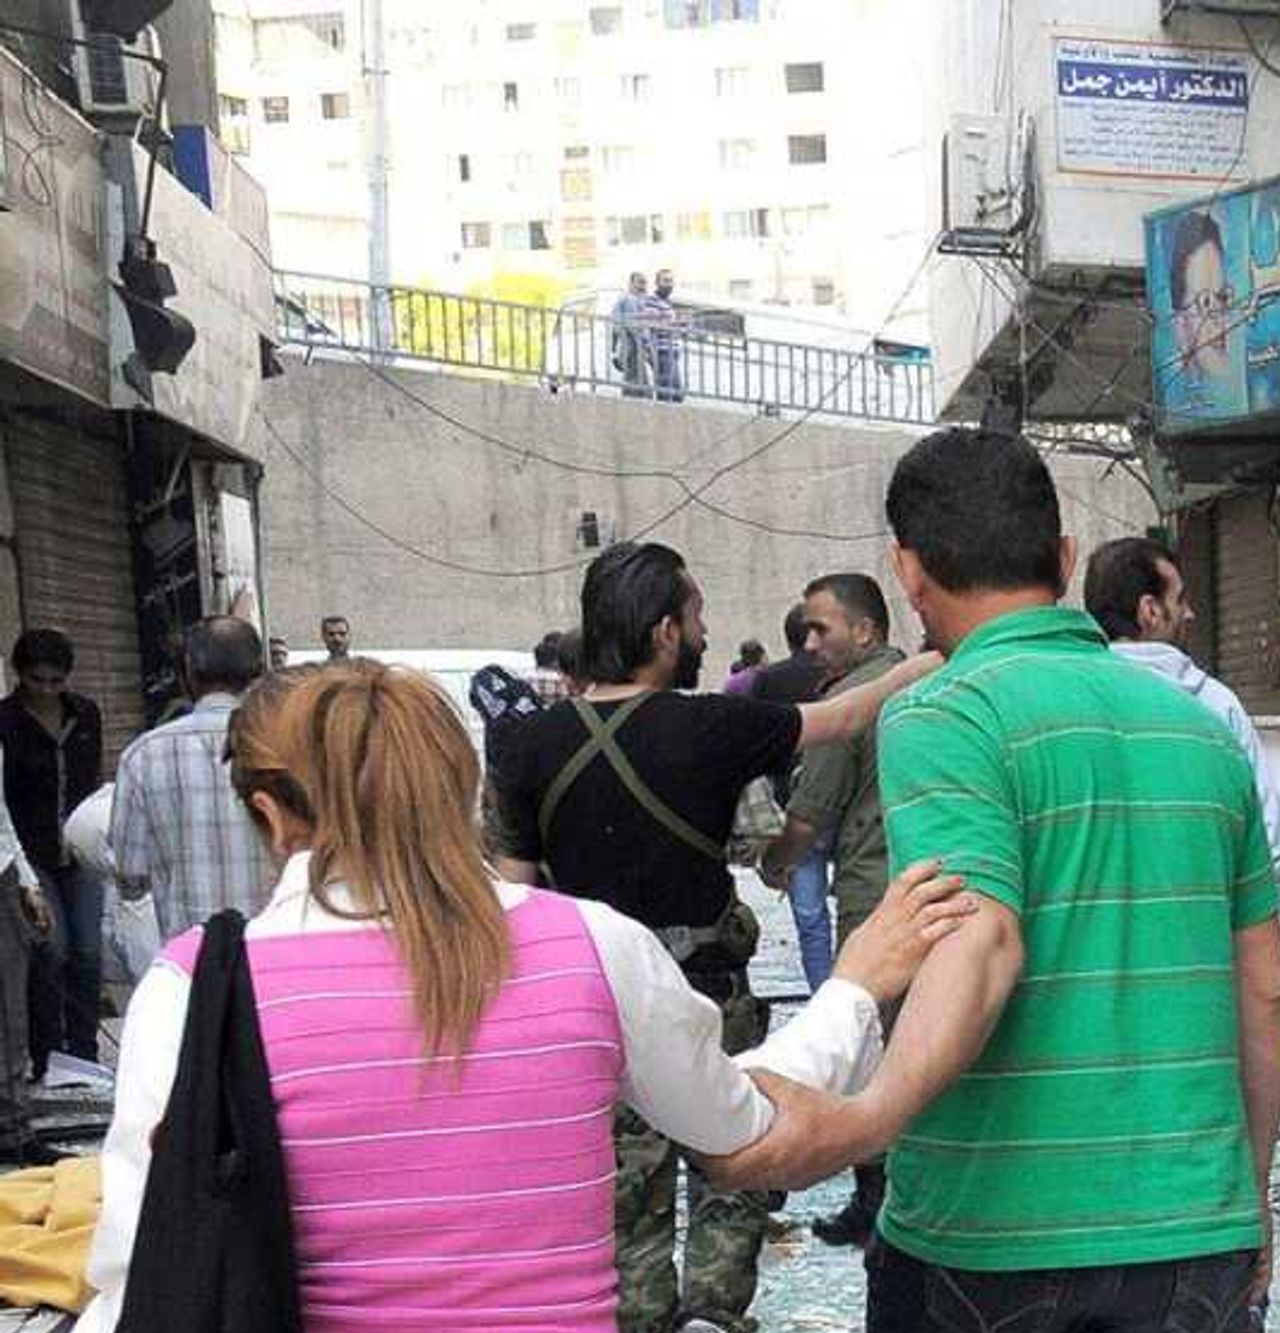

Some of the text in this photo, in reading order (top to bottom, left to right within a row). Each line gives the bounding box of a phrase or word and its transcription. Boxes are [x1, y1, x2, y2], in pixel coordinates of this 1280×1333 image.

[1061, 67, 1245, 101] الدكتور أيمن جمل
